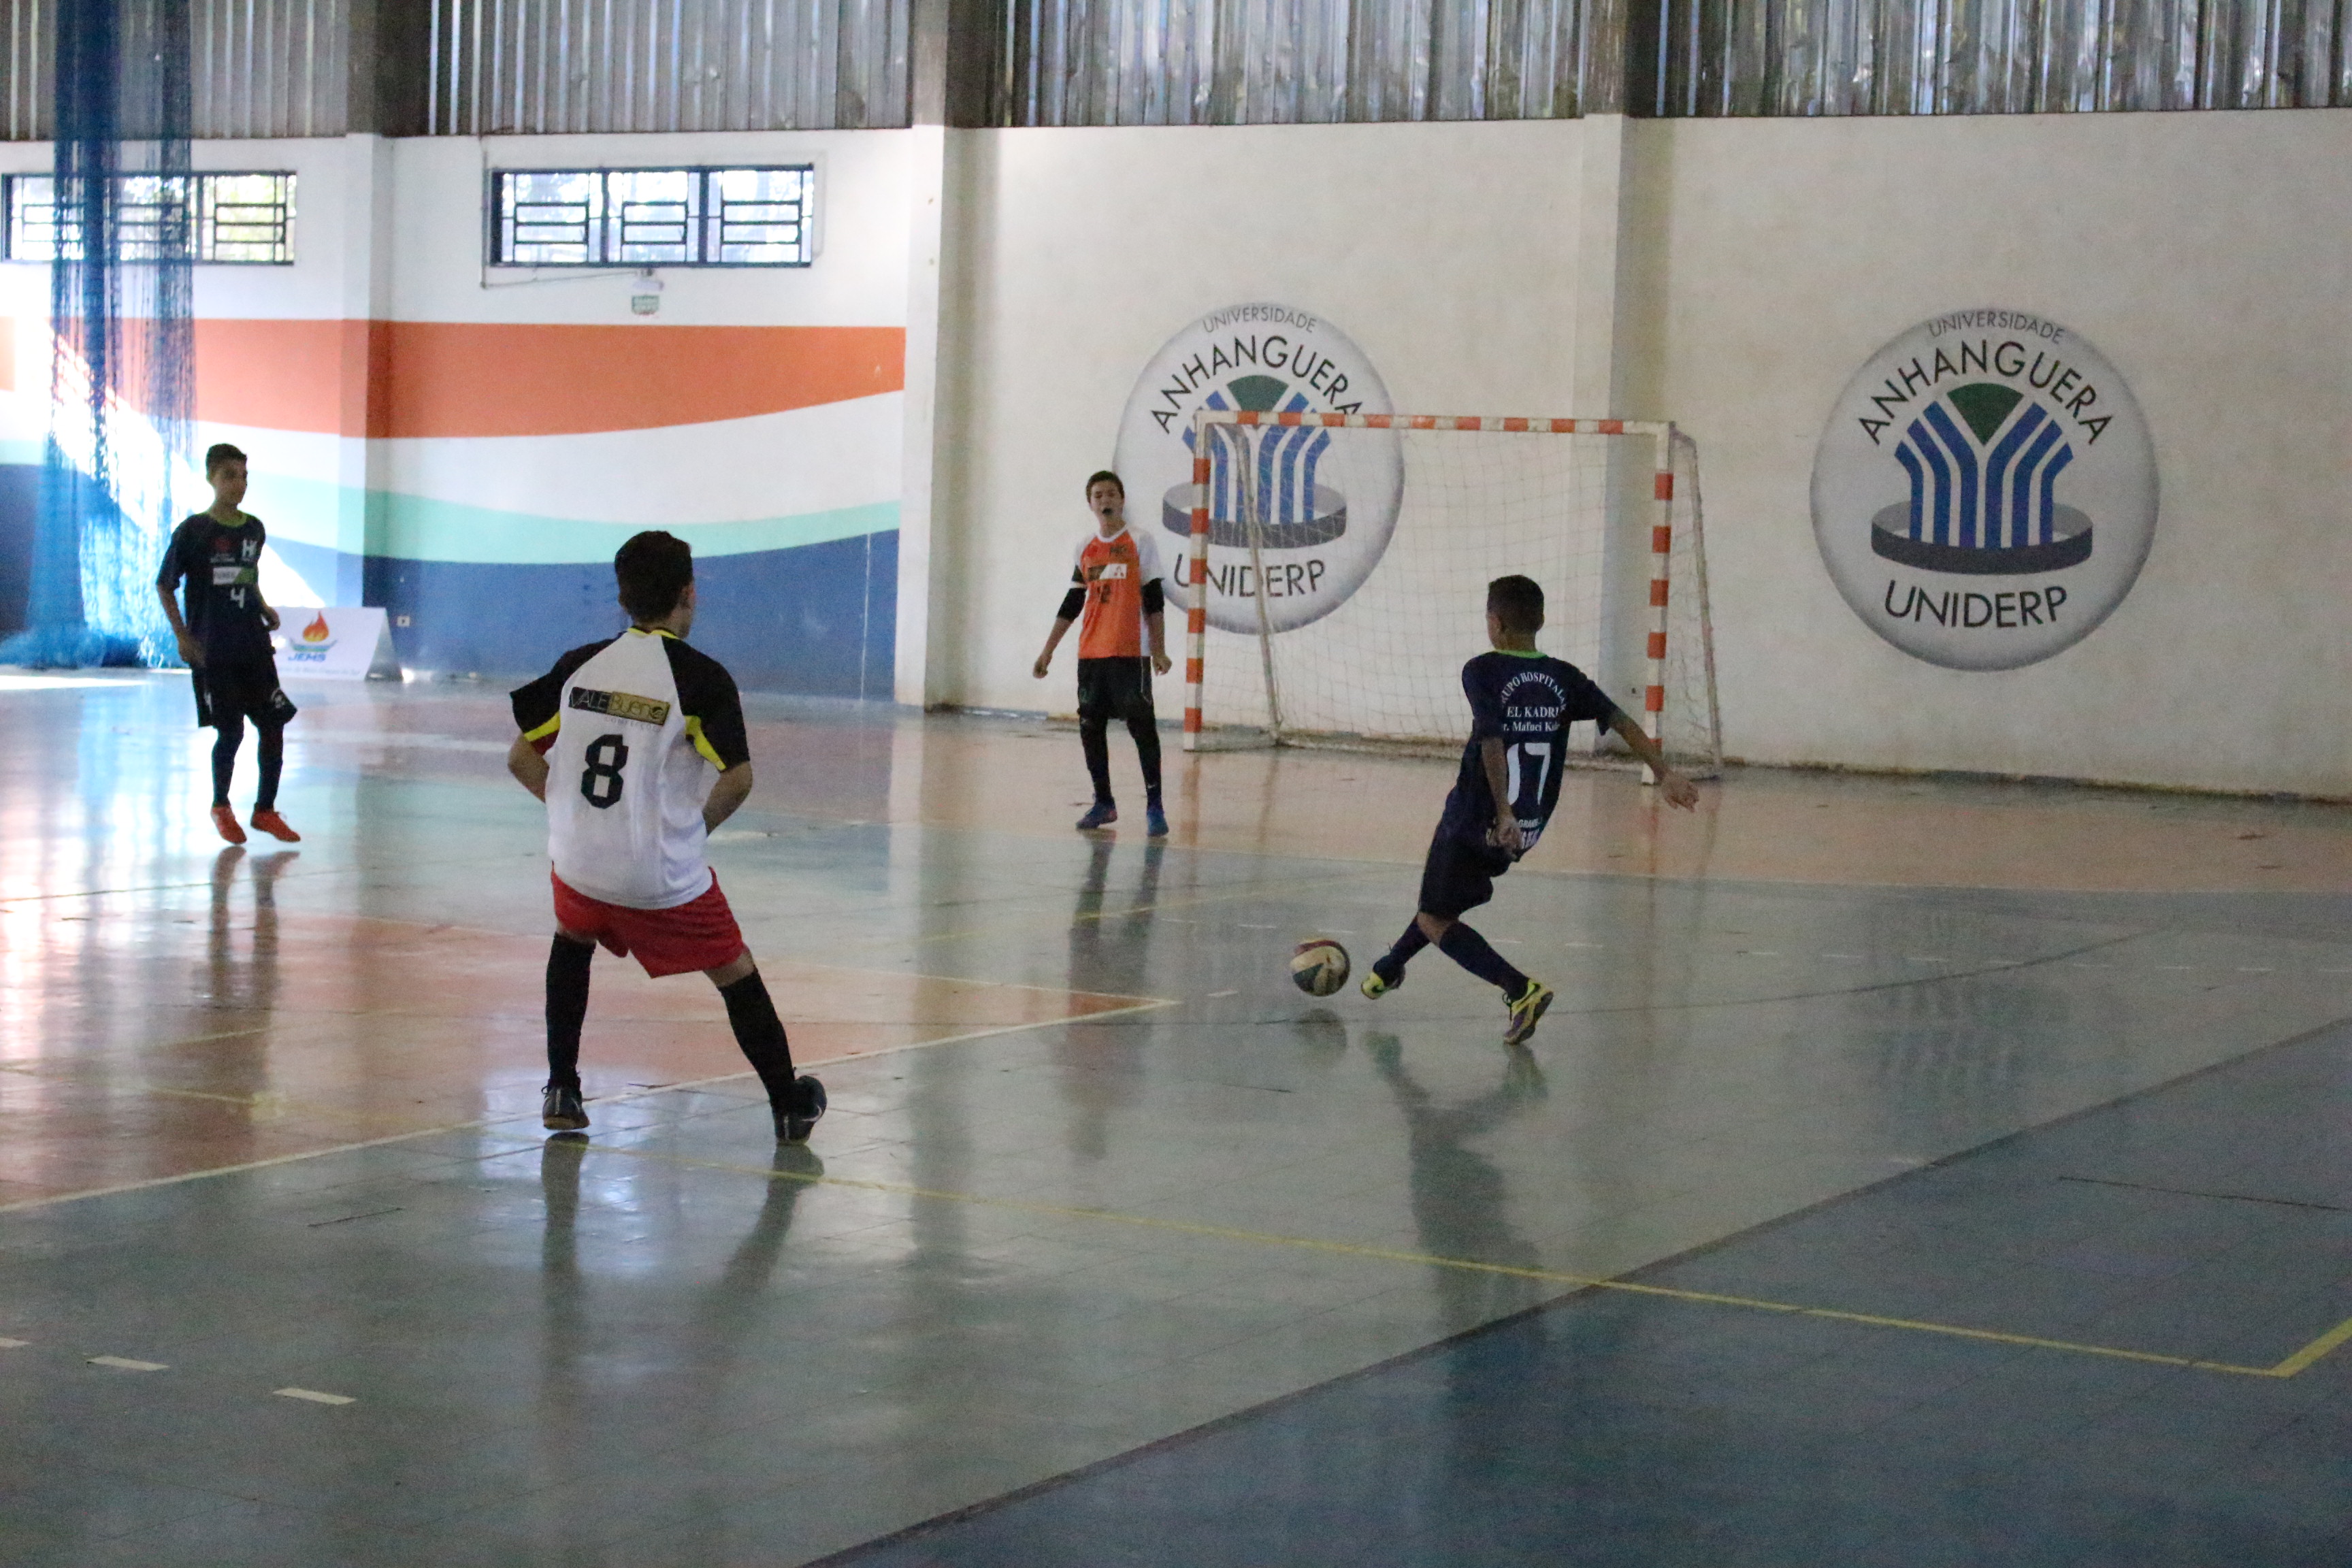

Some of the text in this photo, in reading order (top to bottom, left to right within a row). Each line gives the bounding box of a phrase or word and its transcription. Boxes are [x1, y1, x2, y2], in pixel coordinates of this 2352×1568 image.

[1203, 306, 1318, 333] UNIVERSIDADE
[1927, 310, 2065, 344] UNIVERSIDADE
[1858, 340, 2114, 445] ANHANGUERA
[230, 586, 245, 609] 4
[1884, 579, 2068, 629] UNIDERP
[288, 652, 327, 662] JEMS
[1507, 706, 1559, 718] EL KADRI
[581, 734, 629, 809] 8
